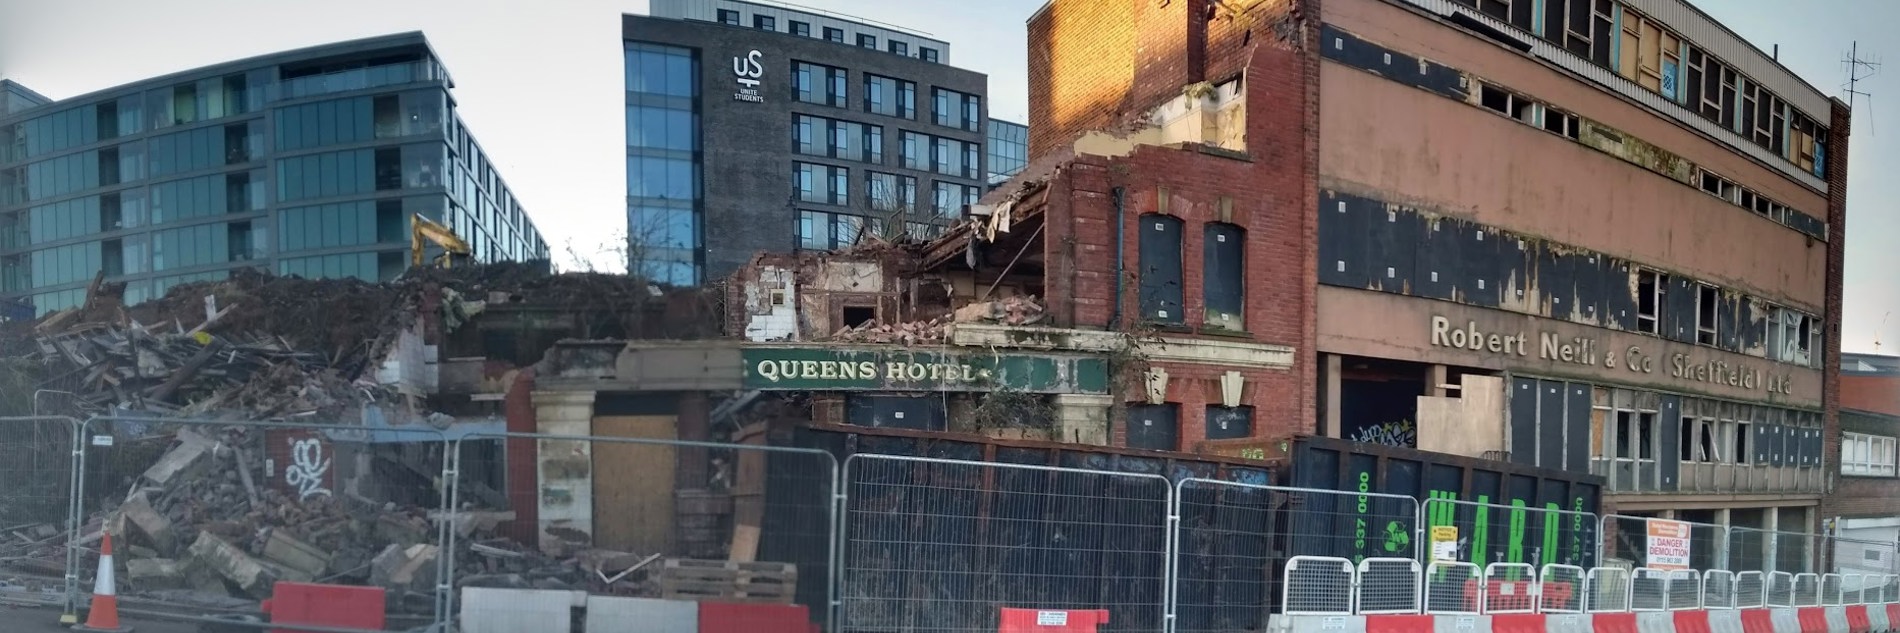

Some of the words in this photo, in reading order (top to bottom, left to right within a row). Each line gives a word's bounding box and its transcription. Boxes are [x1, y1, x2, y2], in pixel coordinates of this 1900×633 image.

[734, 94, 763, 102] STUDENTS
[1430, 315, 1528, 356] Robert
[1539, 331, 1596, 365] Neill
[1604, 351, 1617, 368] &
[1625, 346, 1651, 373] Co
[1767, 373, 1792, 395] Ltd
[757, 359, 877, 382] QUEENS
[885, 361, 976, 381] HOTEL
[1357, 471, 1369, 513] 0000
[1574, 496, 1583, 532] 0000
[1355, 517, 1366, 549] 337
[1657, 538, 1683, 547] DANGER
[1572, 535, 1580, 561] 337
[1649, 547, 1688, 557] DEMOLITION
